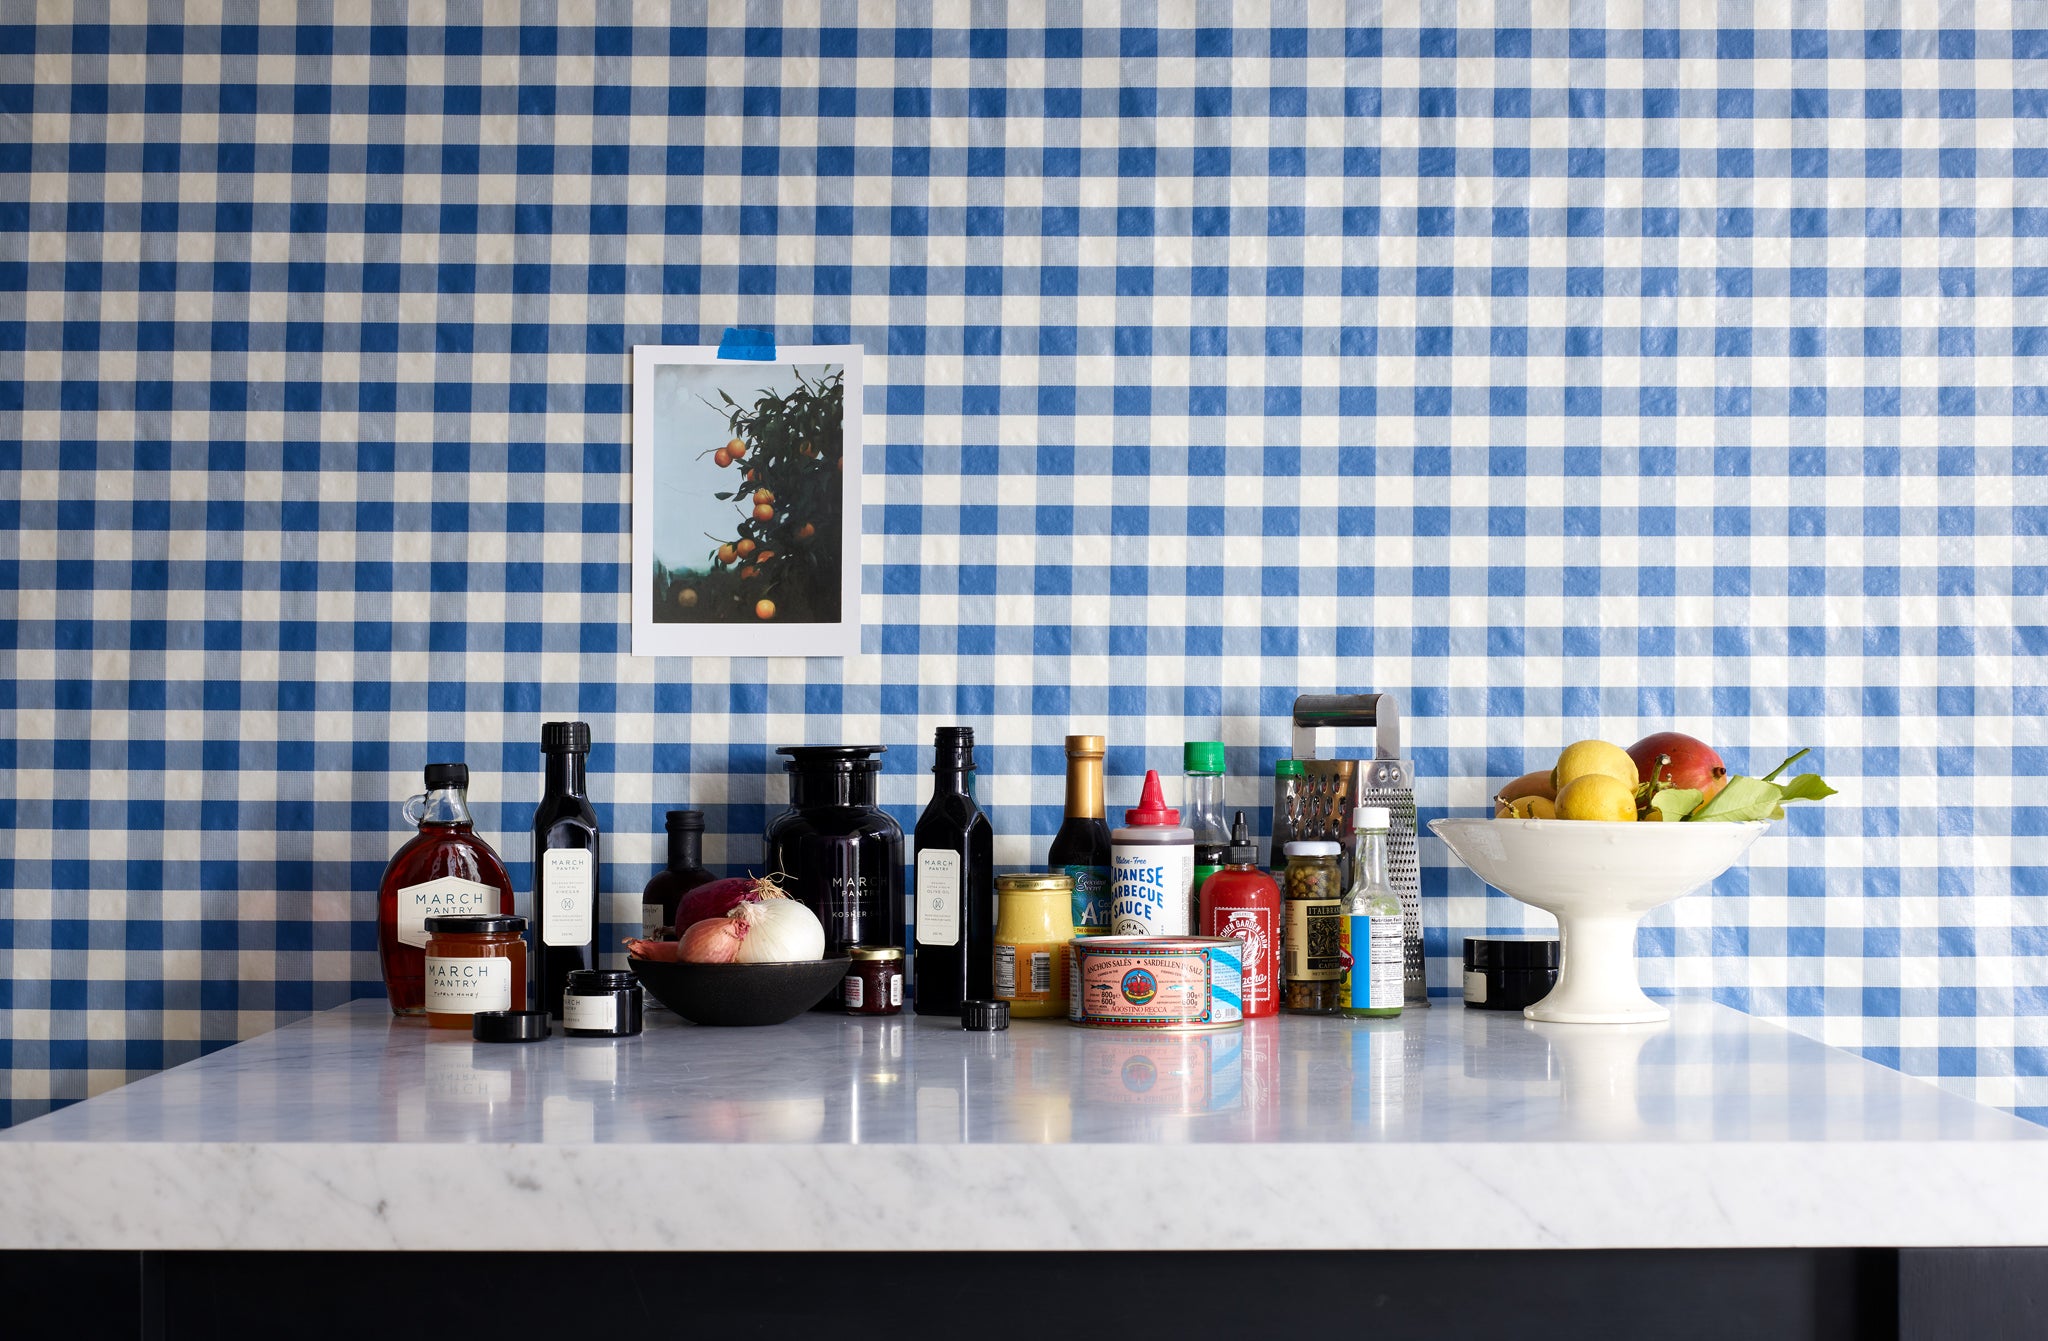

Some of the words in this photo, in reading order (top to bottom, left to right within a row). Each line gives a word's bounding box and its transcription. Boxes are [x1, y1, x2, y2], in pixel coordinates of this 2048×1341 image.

[1115, 855, 1147, 865] Gluten-Free
[415, 893, 483, 905] MARCH
[425, 906, 473, 915] PANTRY
[832, 910, 867, 918] KOSHER
[1113, 900, 1152, 921] SAUCE
[1219, 921, 1236, 938] CHEN
[1235, 919, 1261, 933] GARDEN
[428, 965, 488, 978] MARCH
[1087, 960, 1112, 974] ANCHOIS
[1143, 958, 1181, 969] SARDELLEN
[434, 978, 478, 988] PANTRY
